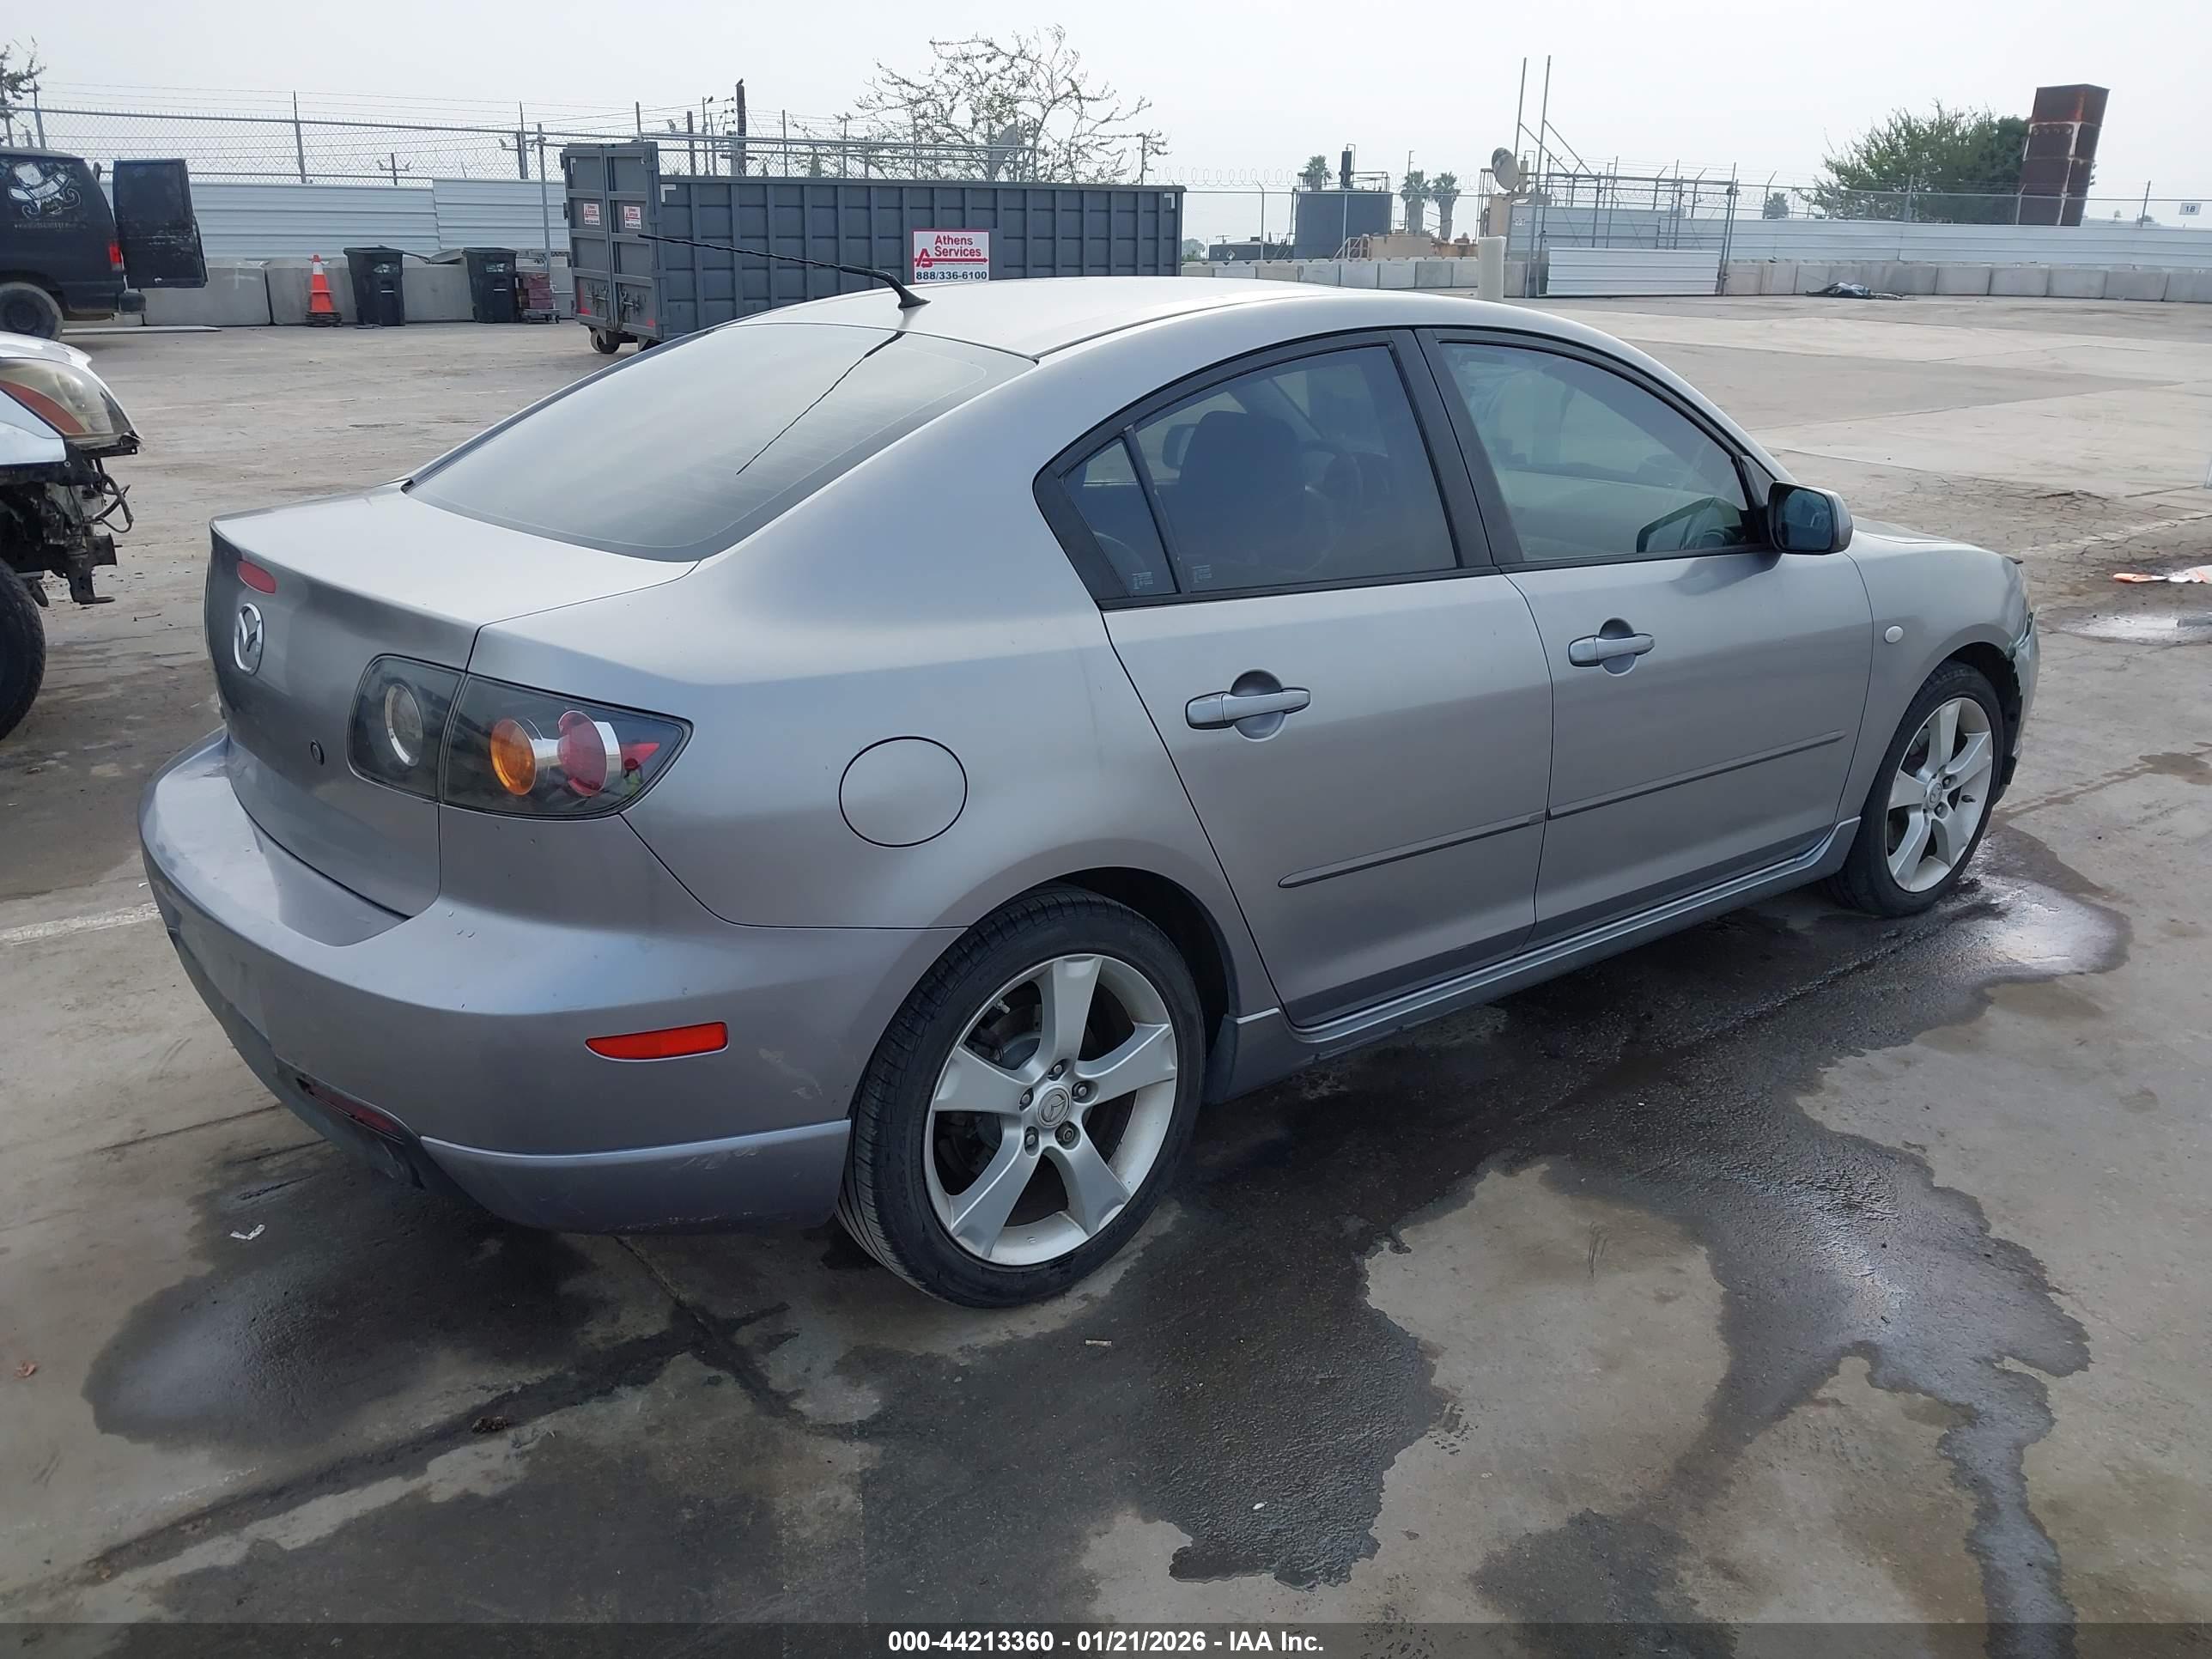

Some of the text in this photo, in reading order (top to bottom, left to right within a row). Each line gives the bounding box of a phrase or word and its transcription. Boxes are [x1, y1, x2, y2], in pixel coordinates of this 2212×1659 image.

[934, 234, 974, 246] Athens
[934, 246, 981, 257] Services
[915, 271, 988, 280] 888/336-6100
